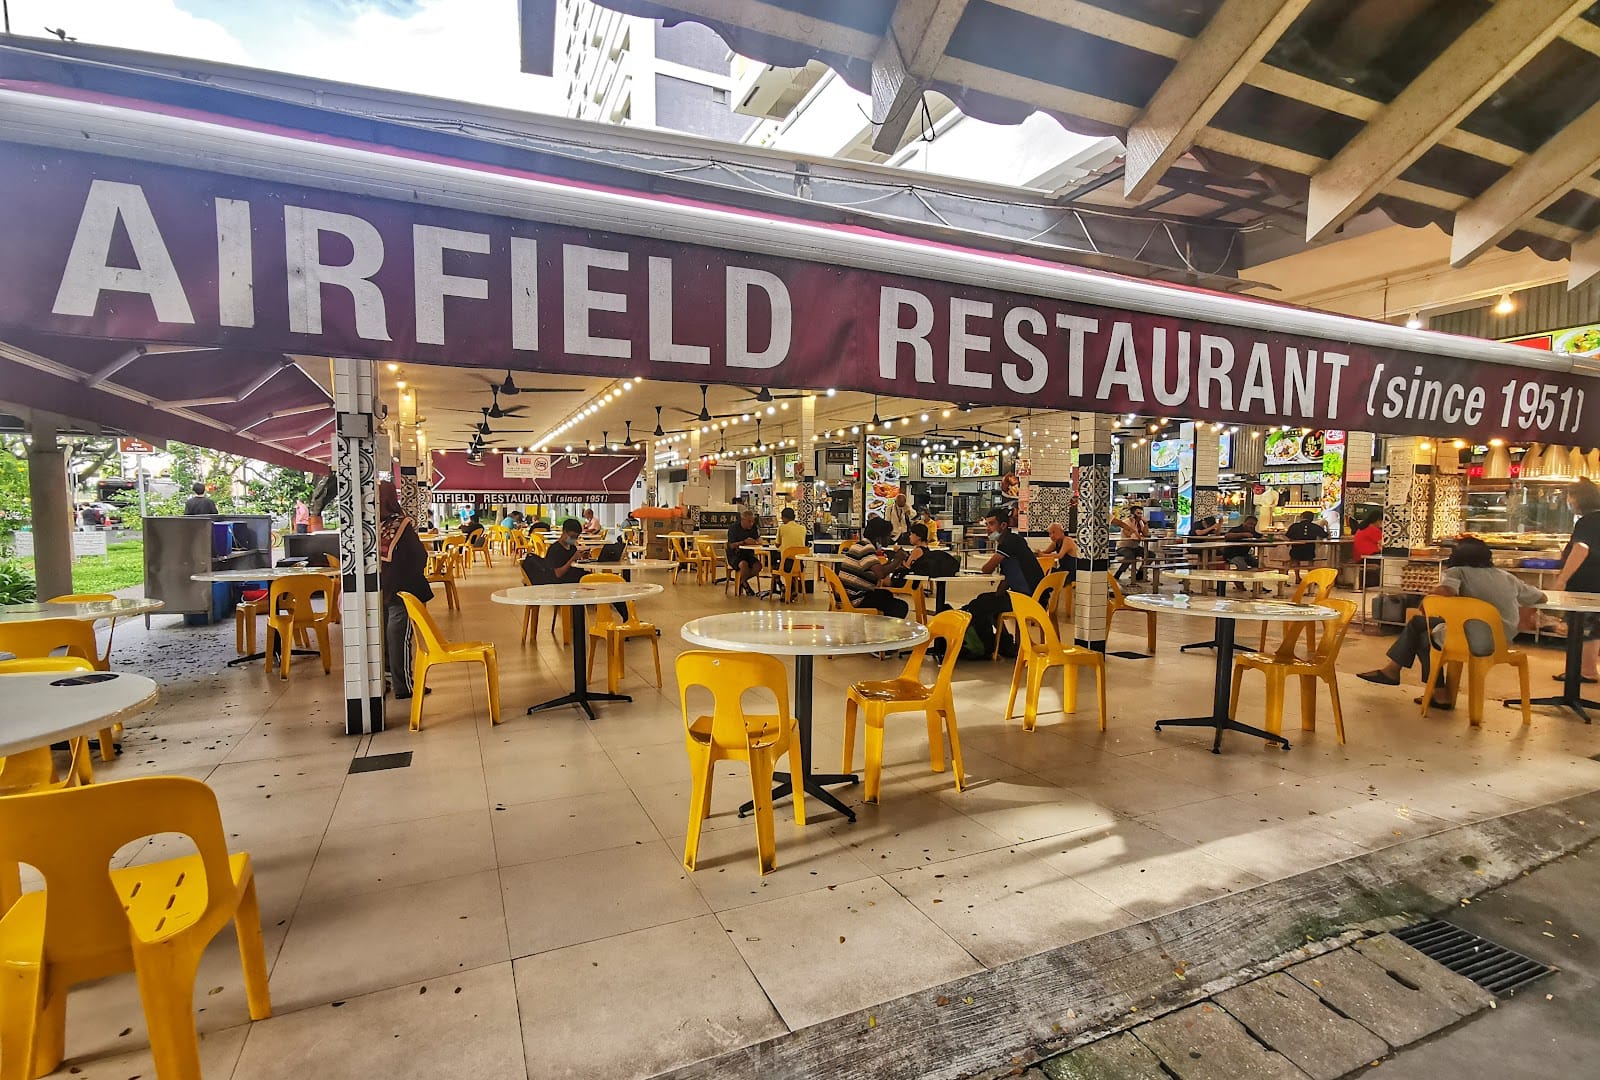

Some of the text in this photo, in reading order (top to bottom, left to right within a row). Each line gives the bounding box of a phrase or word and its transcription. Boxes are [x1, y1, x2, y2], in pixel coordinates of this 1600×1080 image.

[51, 178, 1585, 433] AIRFIELD RESTAURANT (since 1951)
[432, 493, 608, 504] IRFIELD RESTAURANT (since 1951)
